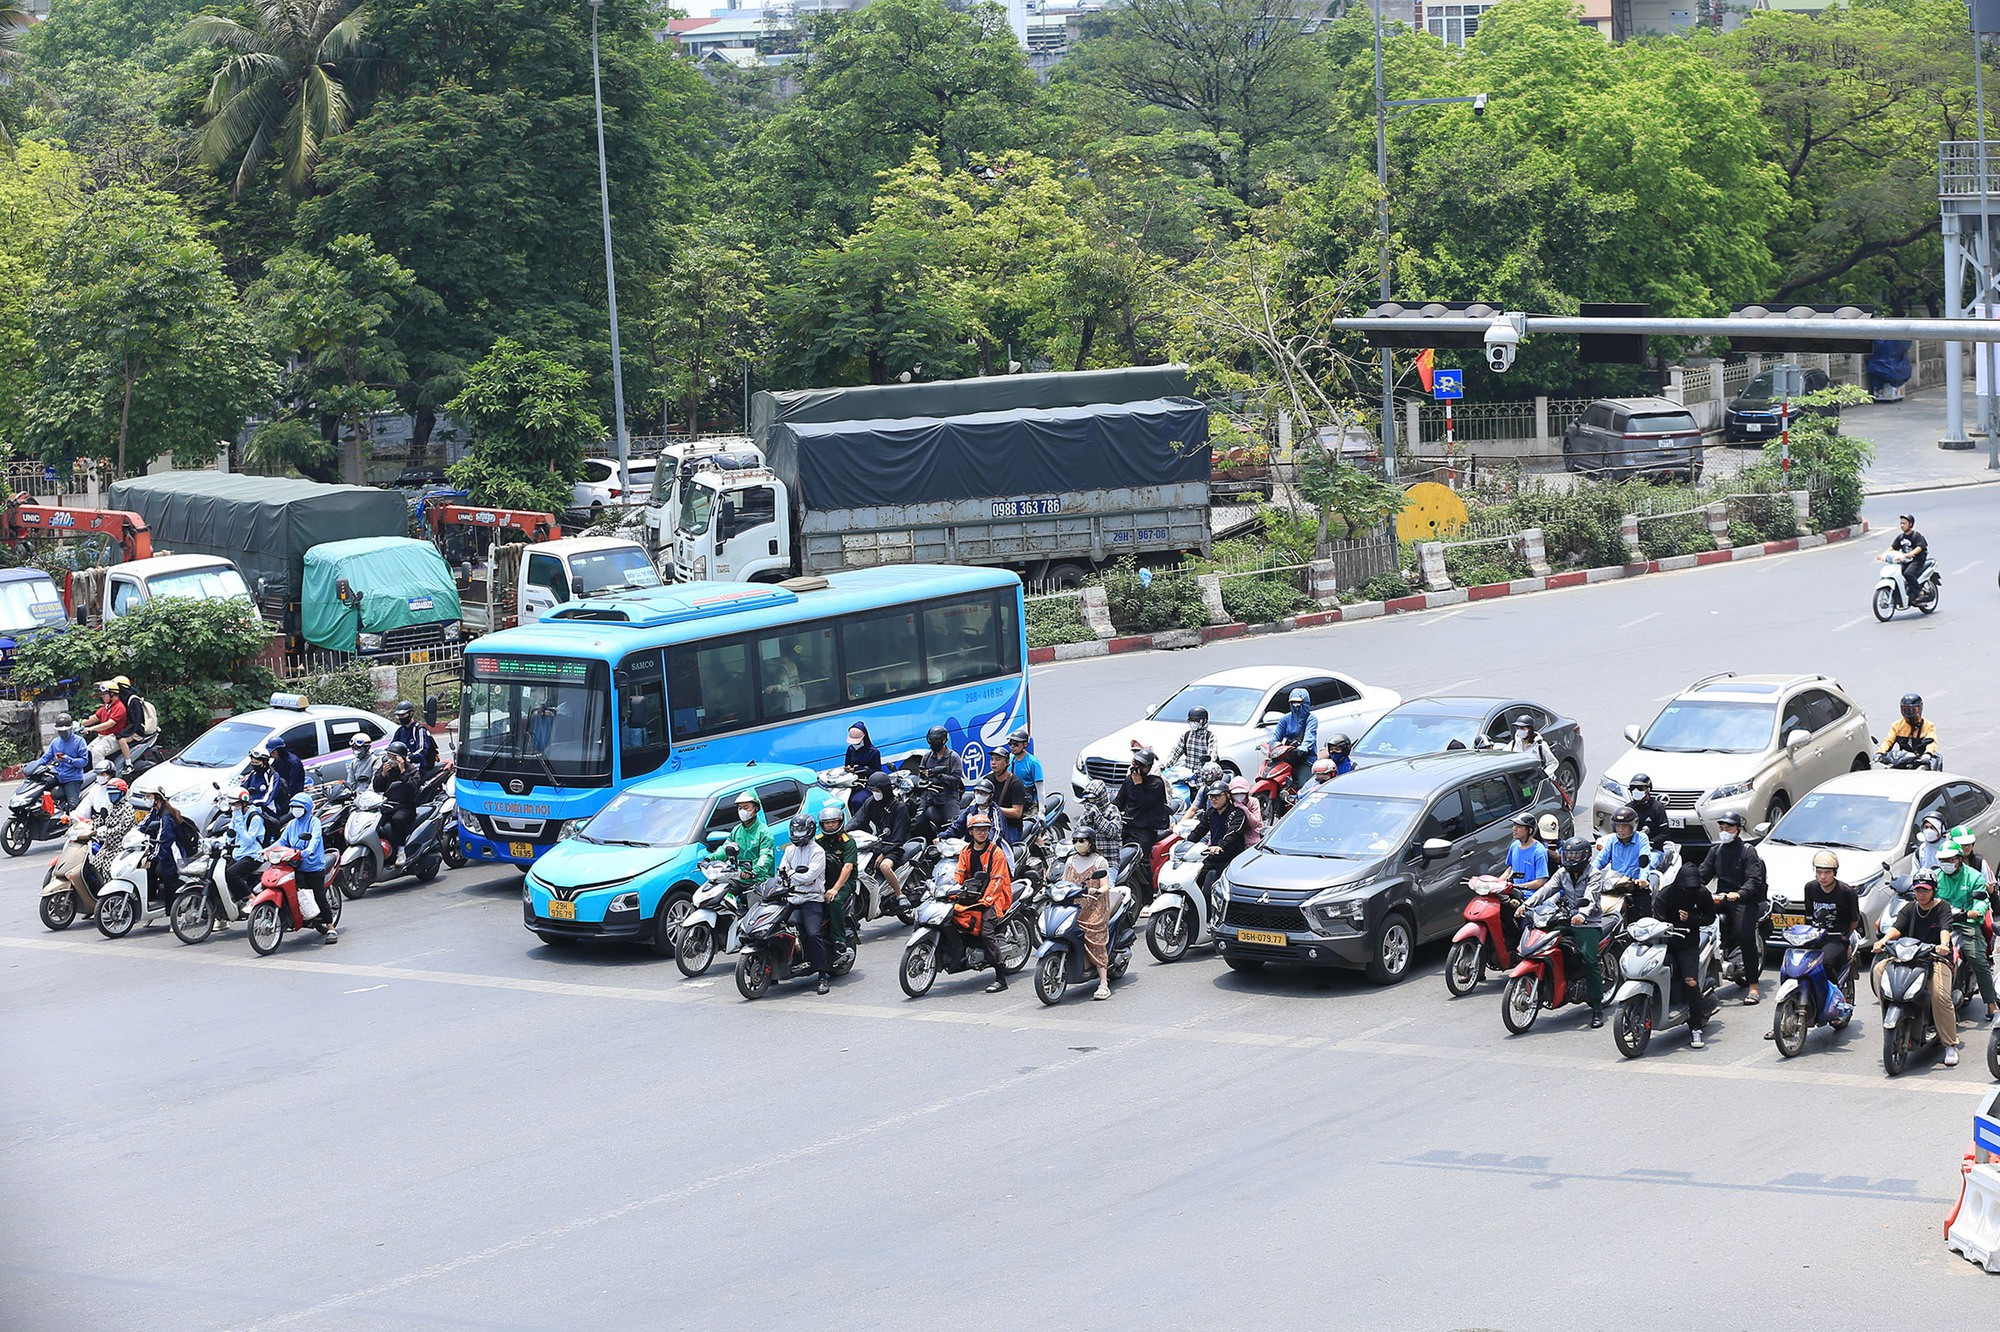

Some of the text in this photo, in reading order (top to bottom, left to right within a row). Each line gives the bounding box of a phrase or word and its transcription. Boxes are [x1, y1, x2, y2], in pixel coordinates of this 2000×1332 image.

[992, 500, 1060, 517] 0988 363 786
[22, 514, 40, 522] UNIC
[631, 660, 654, 670] SAMCO
[483, 801, 493, 811] CT
[494, 801, 504, 812] XE
[505, 800, 522, 816] ĐIỆN
[535, 802, 551, 817] NỘI
[556, 902, 568, 910] 29H
[1241, 932, 1282, 943] 36H-079.77
